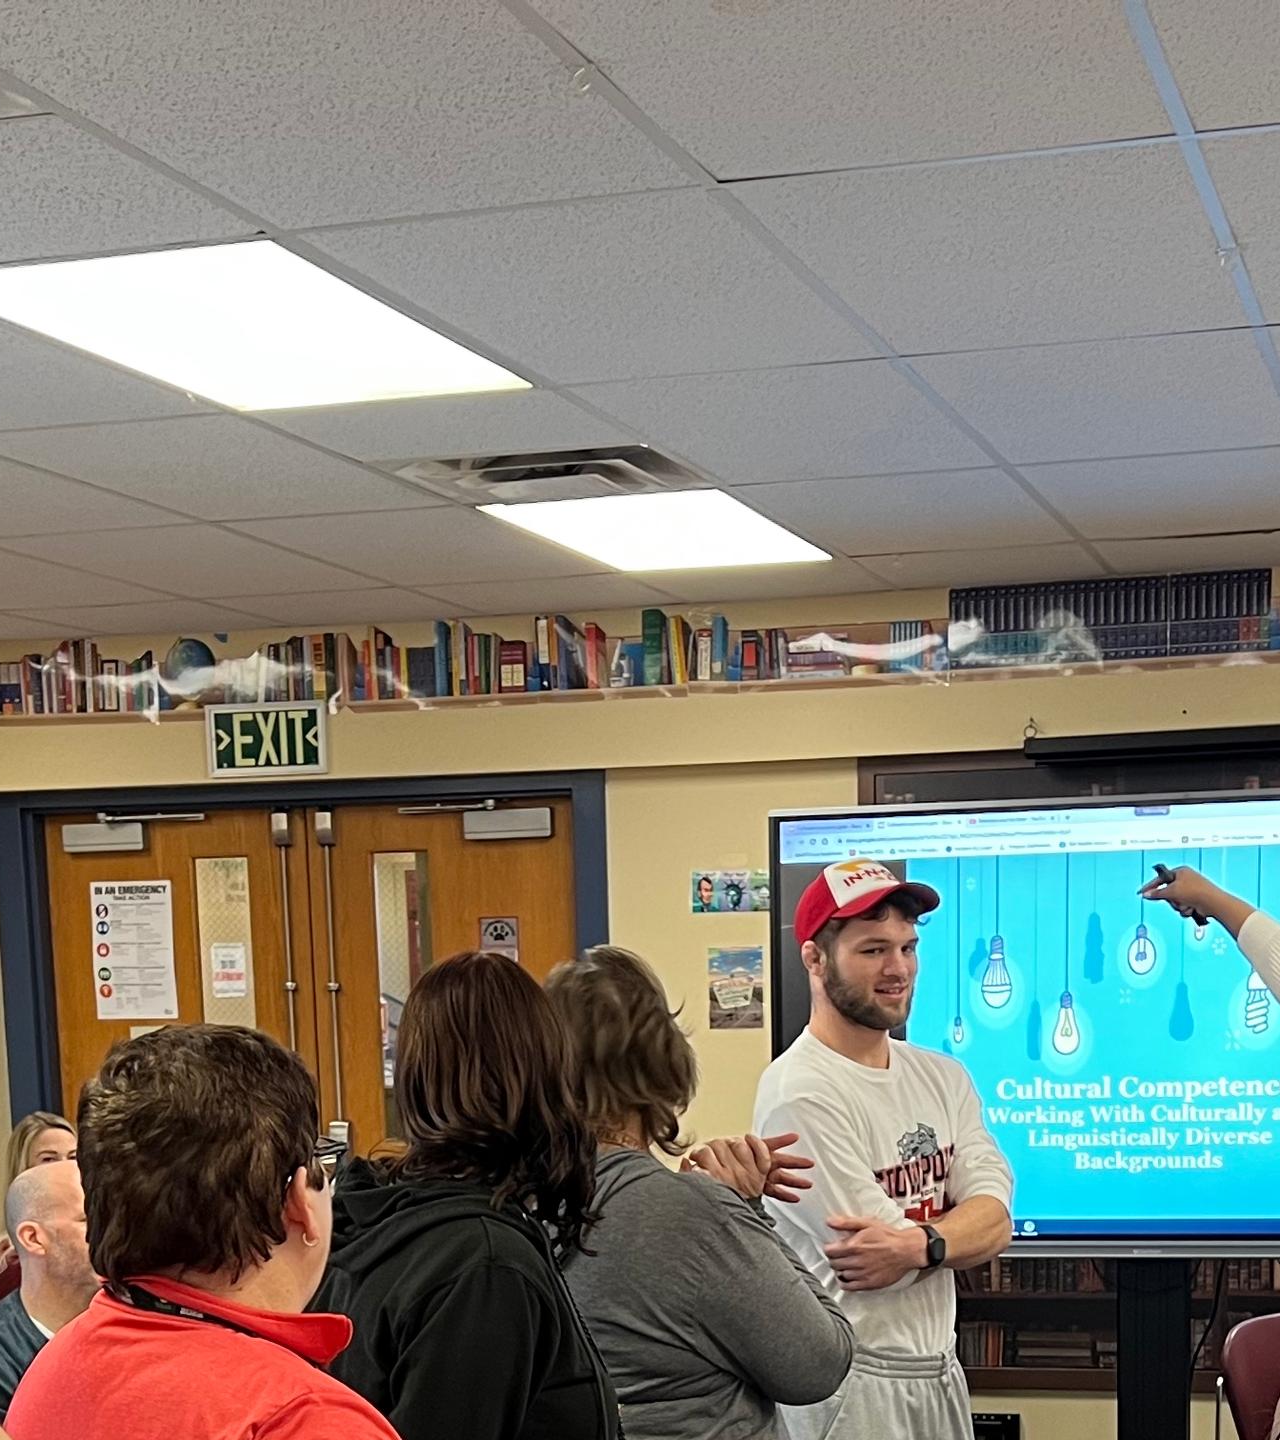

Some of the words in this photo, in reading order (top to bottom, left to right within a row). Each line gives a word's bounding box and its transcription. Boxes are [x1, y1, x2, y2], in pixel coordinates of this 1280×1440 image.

[232, 710, 309, 766] EXIT
[94, 886, 103, 895] IN
[105, 886, 116, 895] AN
[118, 885, 167, 895] EMERGENCY
[996, 1076, 1111, 1100] Cultural
[987, 1106, 1084, 1127] Working
[1089, 1104, 1145, 1123] With
[1151, 1103, 1267, 1125] Culturally
[1028, 1127, 1179, 1150] Linguistically
[1185, 1128, 1273, 1147] Diverse
[1075, 1151, 1224, 1173] Backgrounds
